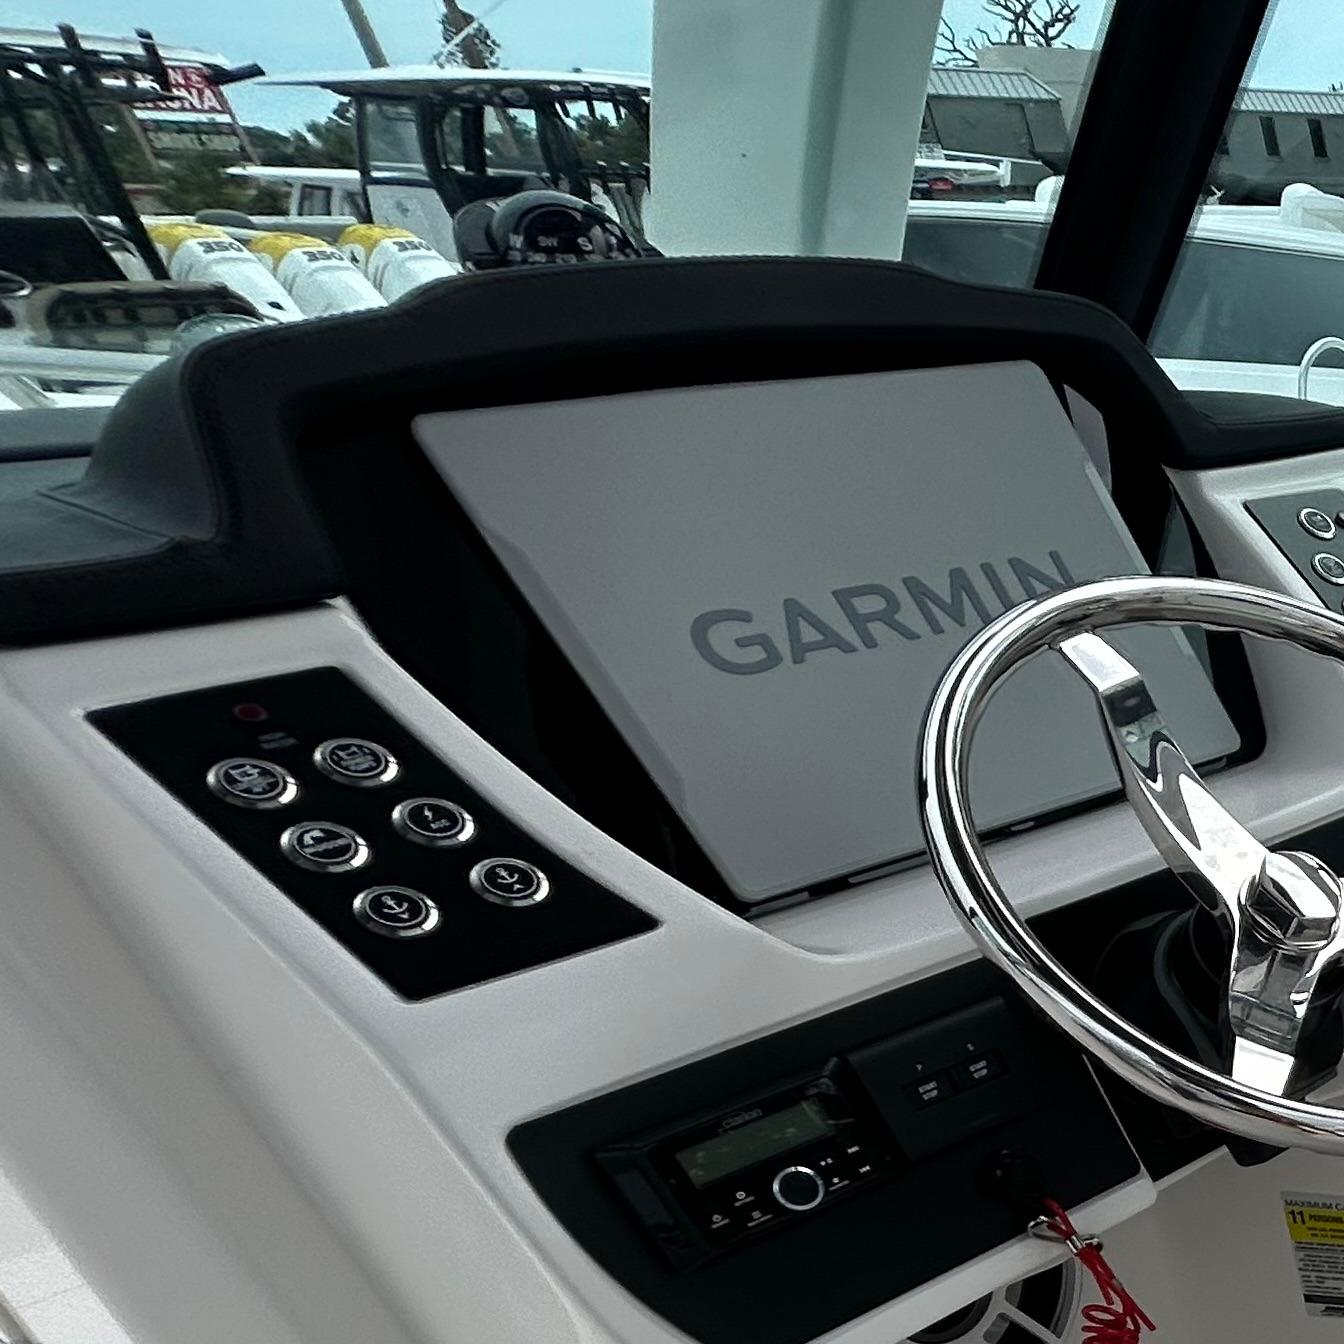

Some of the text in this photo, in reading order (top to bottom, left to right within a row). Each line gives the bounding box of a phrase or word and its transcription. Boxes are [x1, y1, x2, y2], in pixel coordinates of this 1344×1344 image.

[576, 236, 593, 251] S
[301, 250, 346, 263] 350
[689, 550, 1075, 676] GARMIN
[1287, 1209, 1306, 1225] 11
